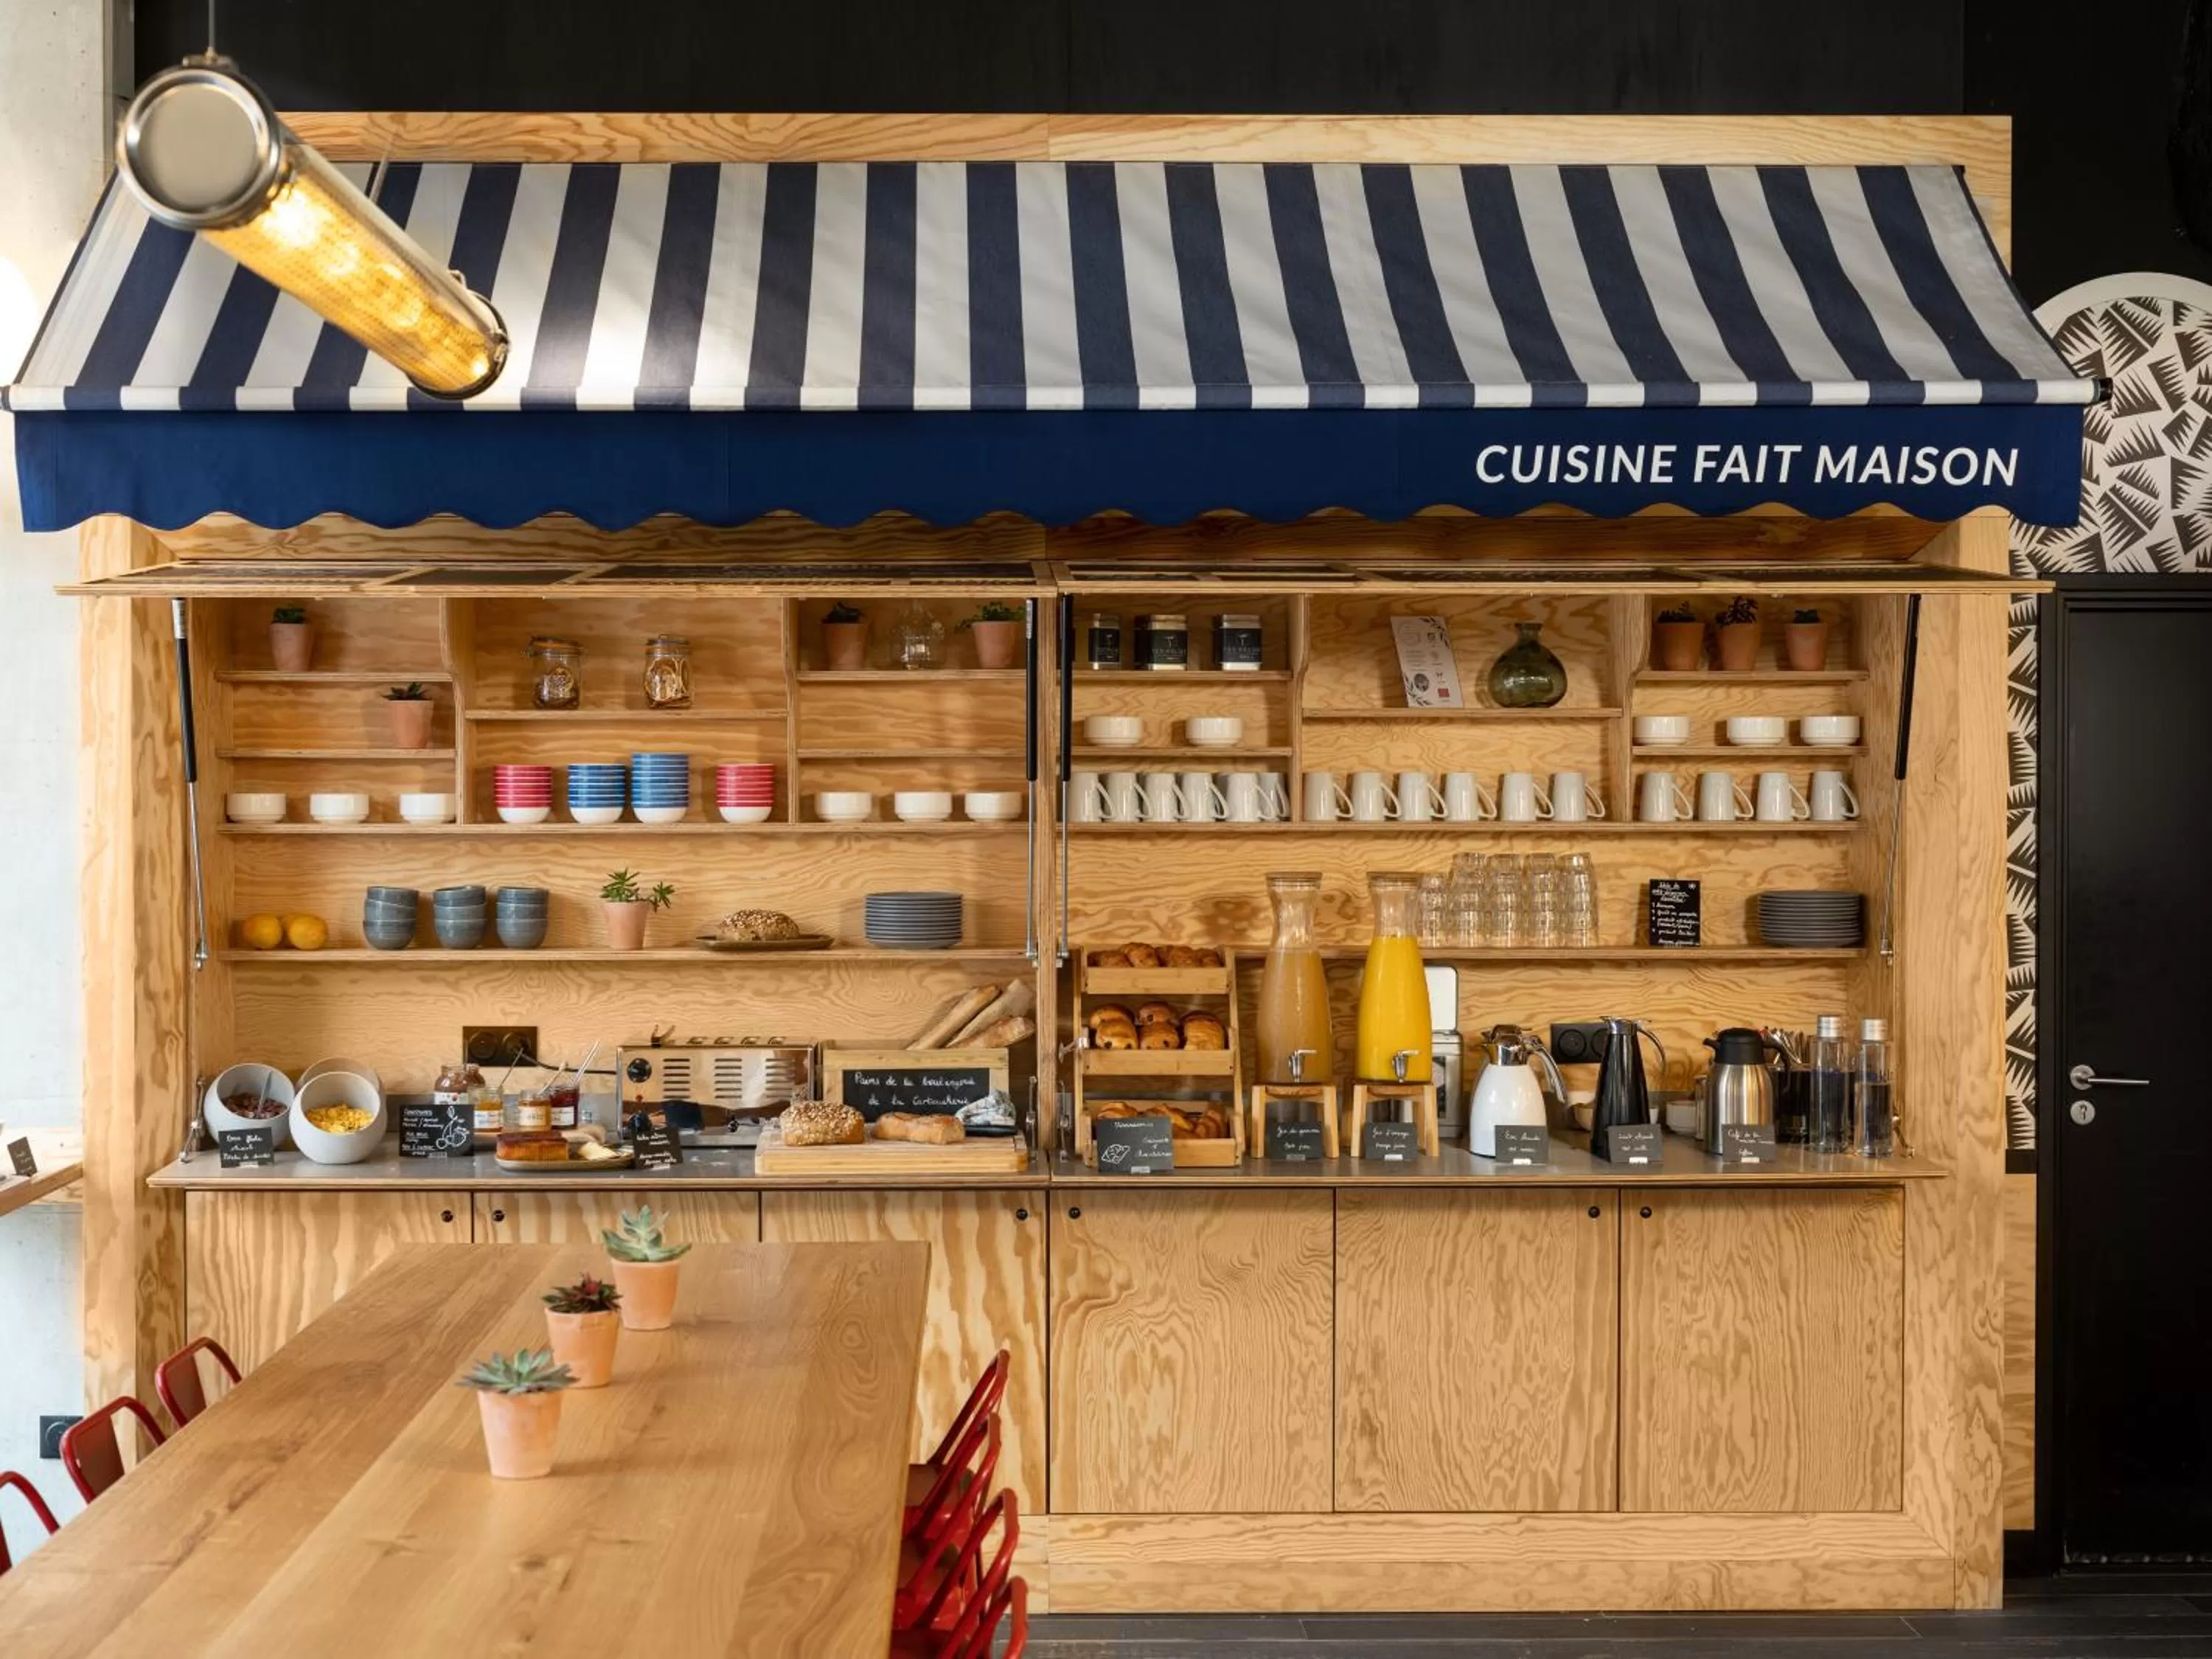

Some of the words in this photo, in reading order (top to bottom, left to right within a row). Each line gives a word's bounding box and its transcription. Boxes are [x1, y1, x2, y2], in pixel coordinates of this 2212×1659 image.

[1475, 445, 1677, 483] CUISINE
[1694, 445, 1801, 483] FAIT
[1814, 445, 2019, 486] MAISON
[855, 1071, 880, 1086] Pains
[886, 1075, 897, 1086] de
[903, 1076, 914, 1086] la
[868, 1093, 880, 1105] de
[891, 1093, 905, 1105] la
